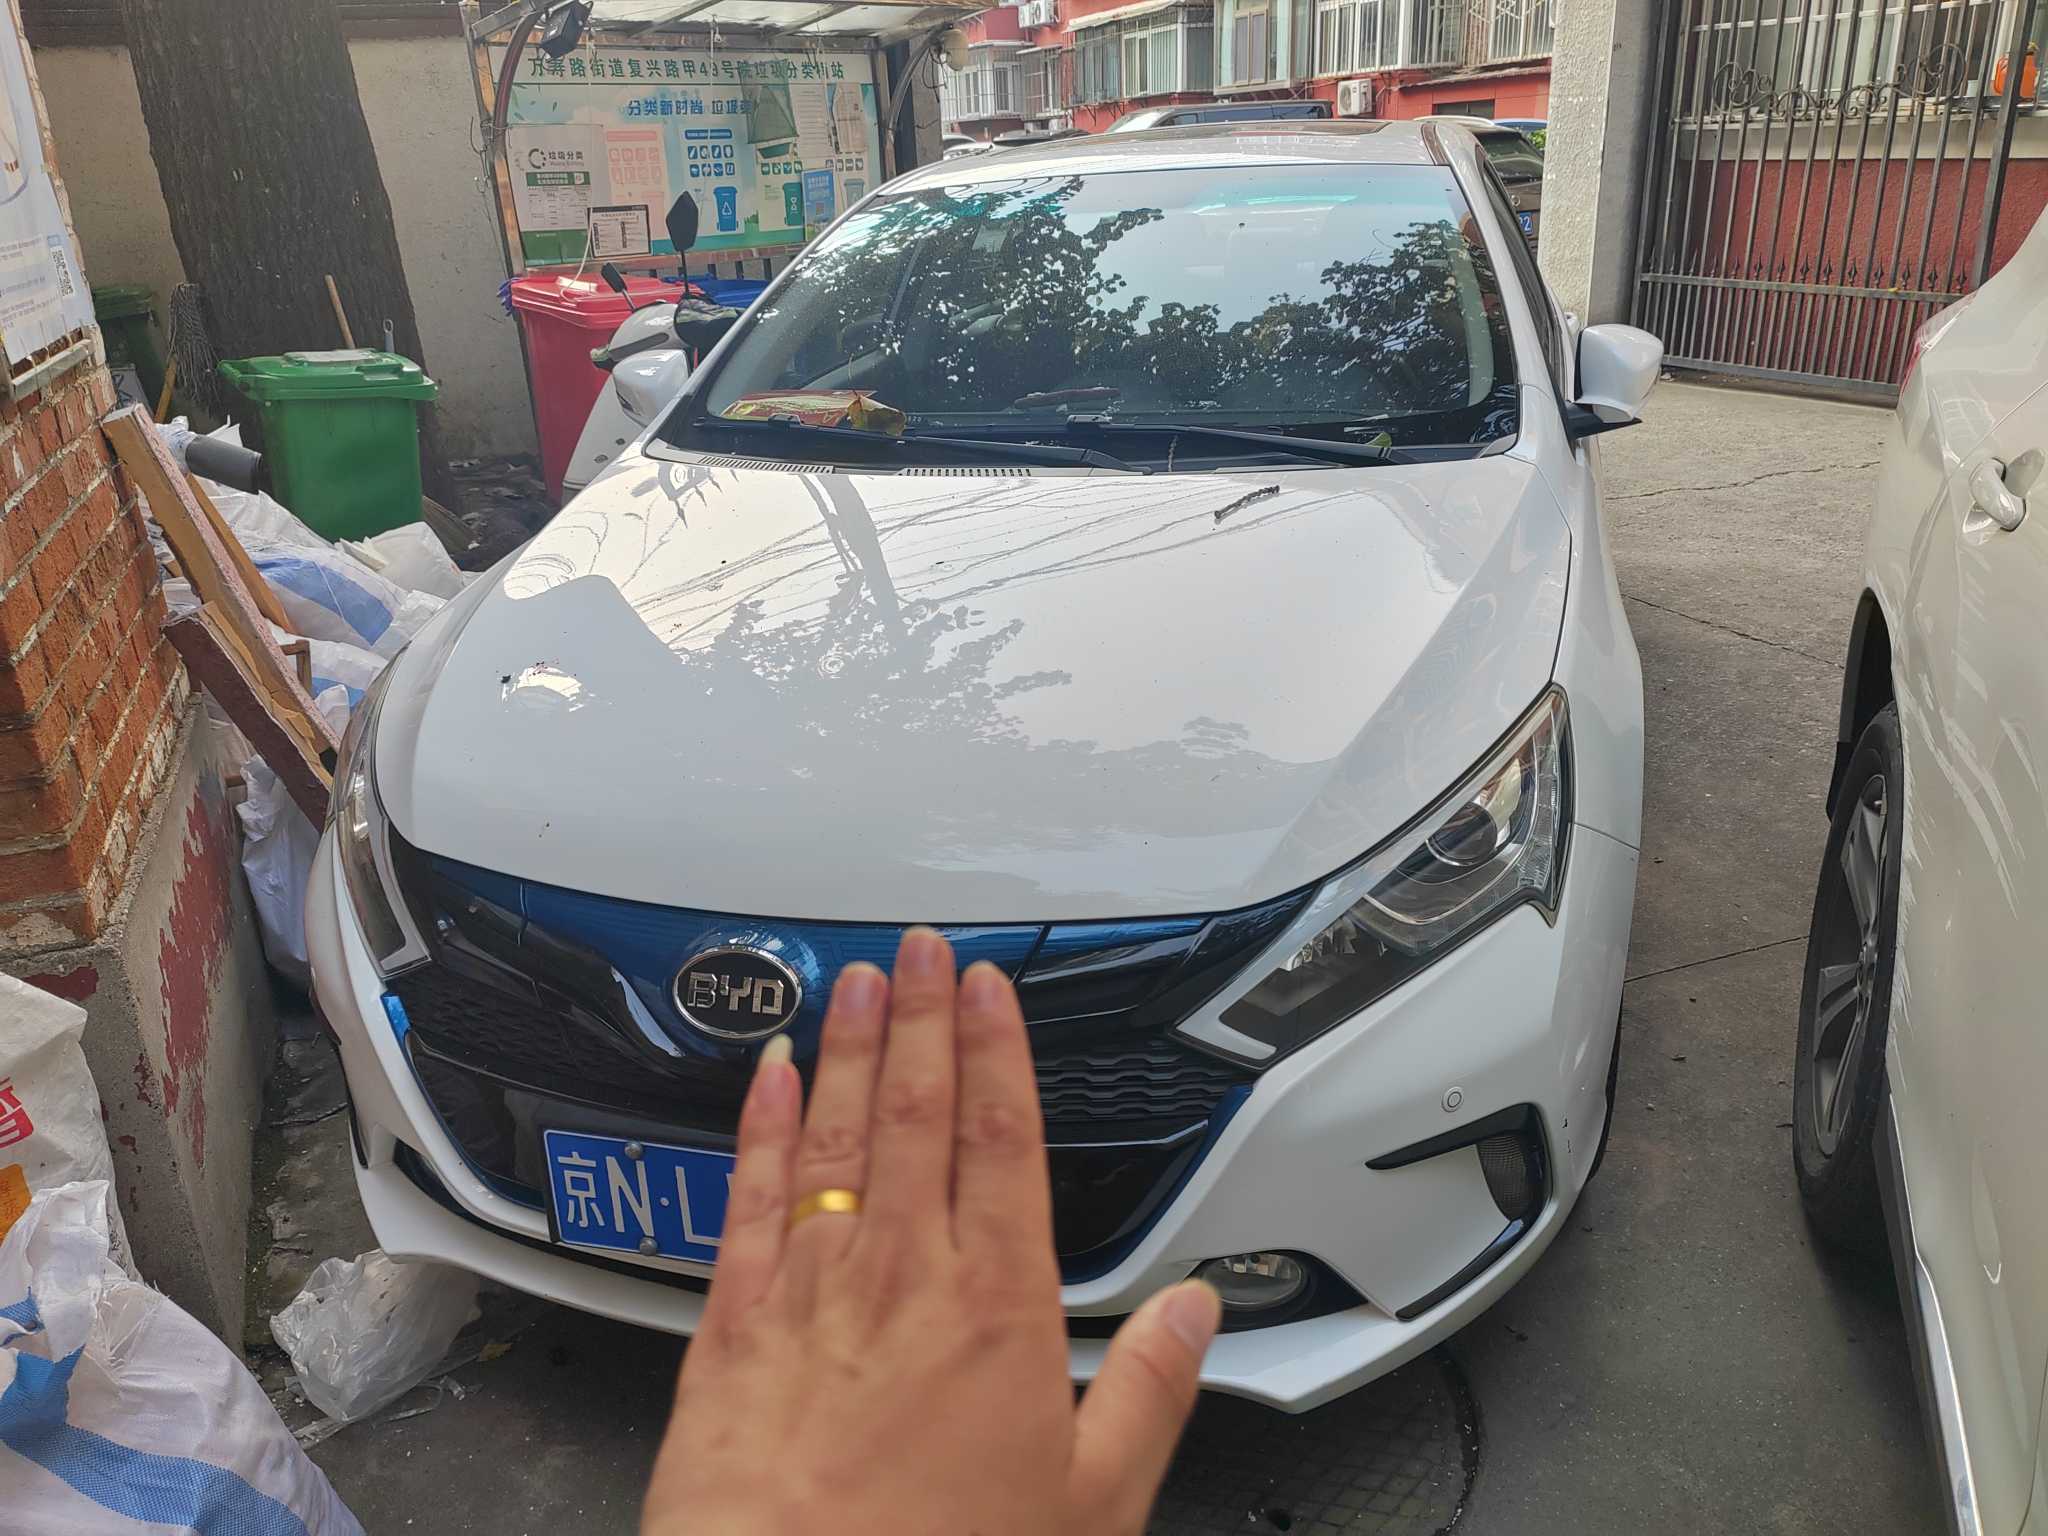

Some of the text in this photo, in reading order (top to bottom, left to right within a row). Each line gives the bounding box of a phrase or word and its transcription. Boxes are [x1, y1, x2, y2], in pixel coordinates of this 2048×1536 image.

[628, 98, 704, 116] 分类新时尚
[687, 971, 785, 1017] BYD
[558, 1151, 737, 1247] 京N·L
